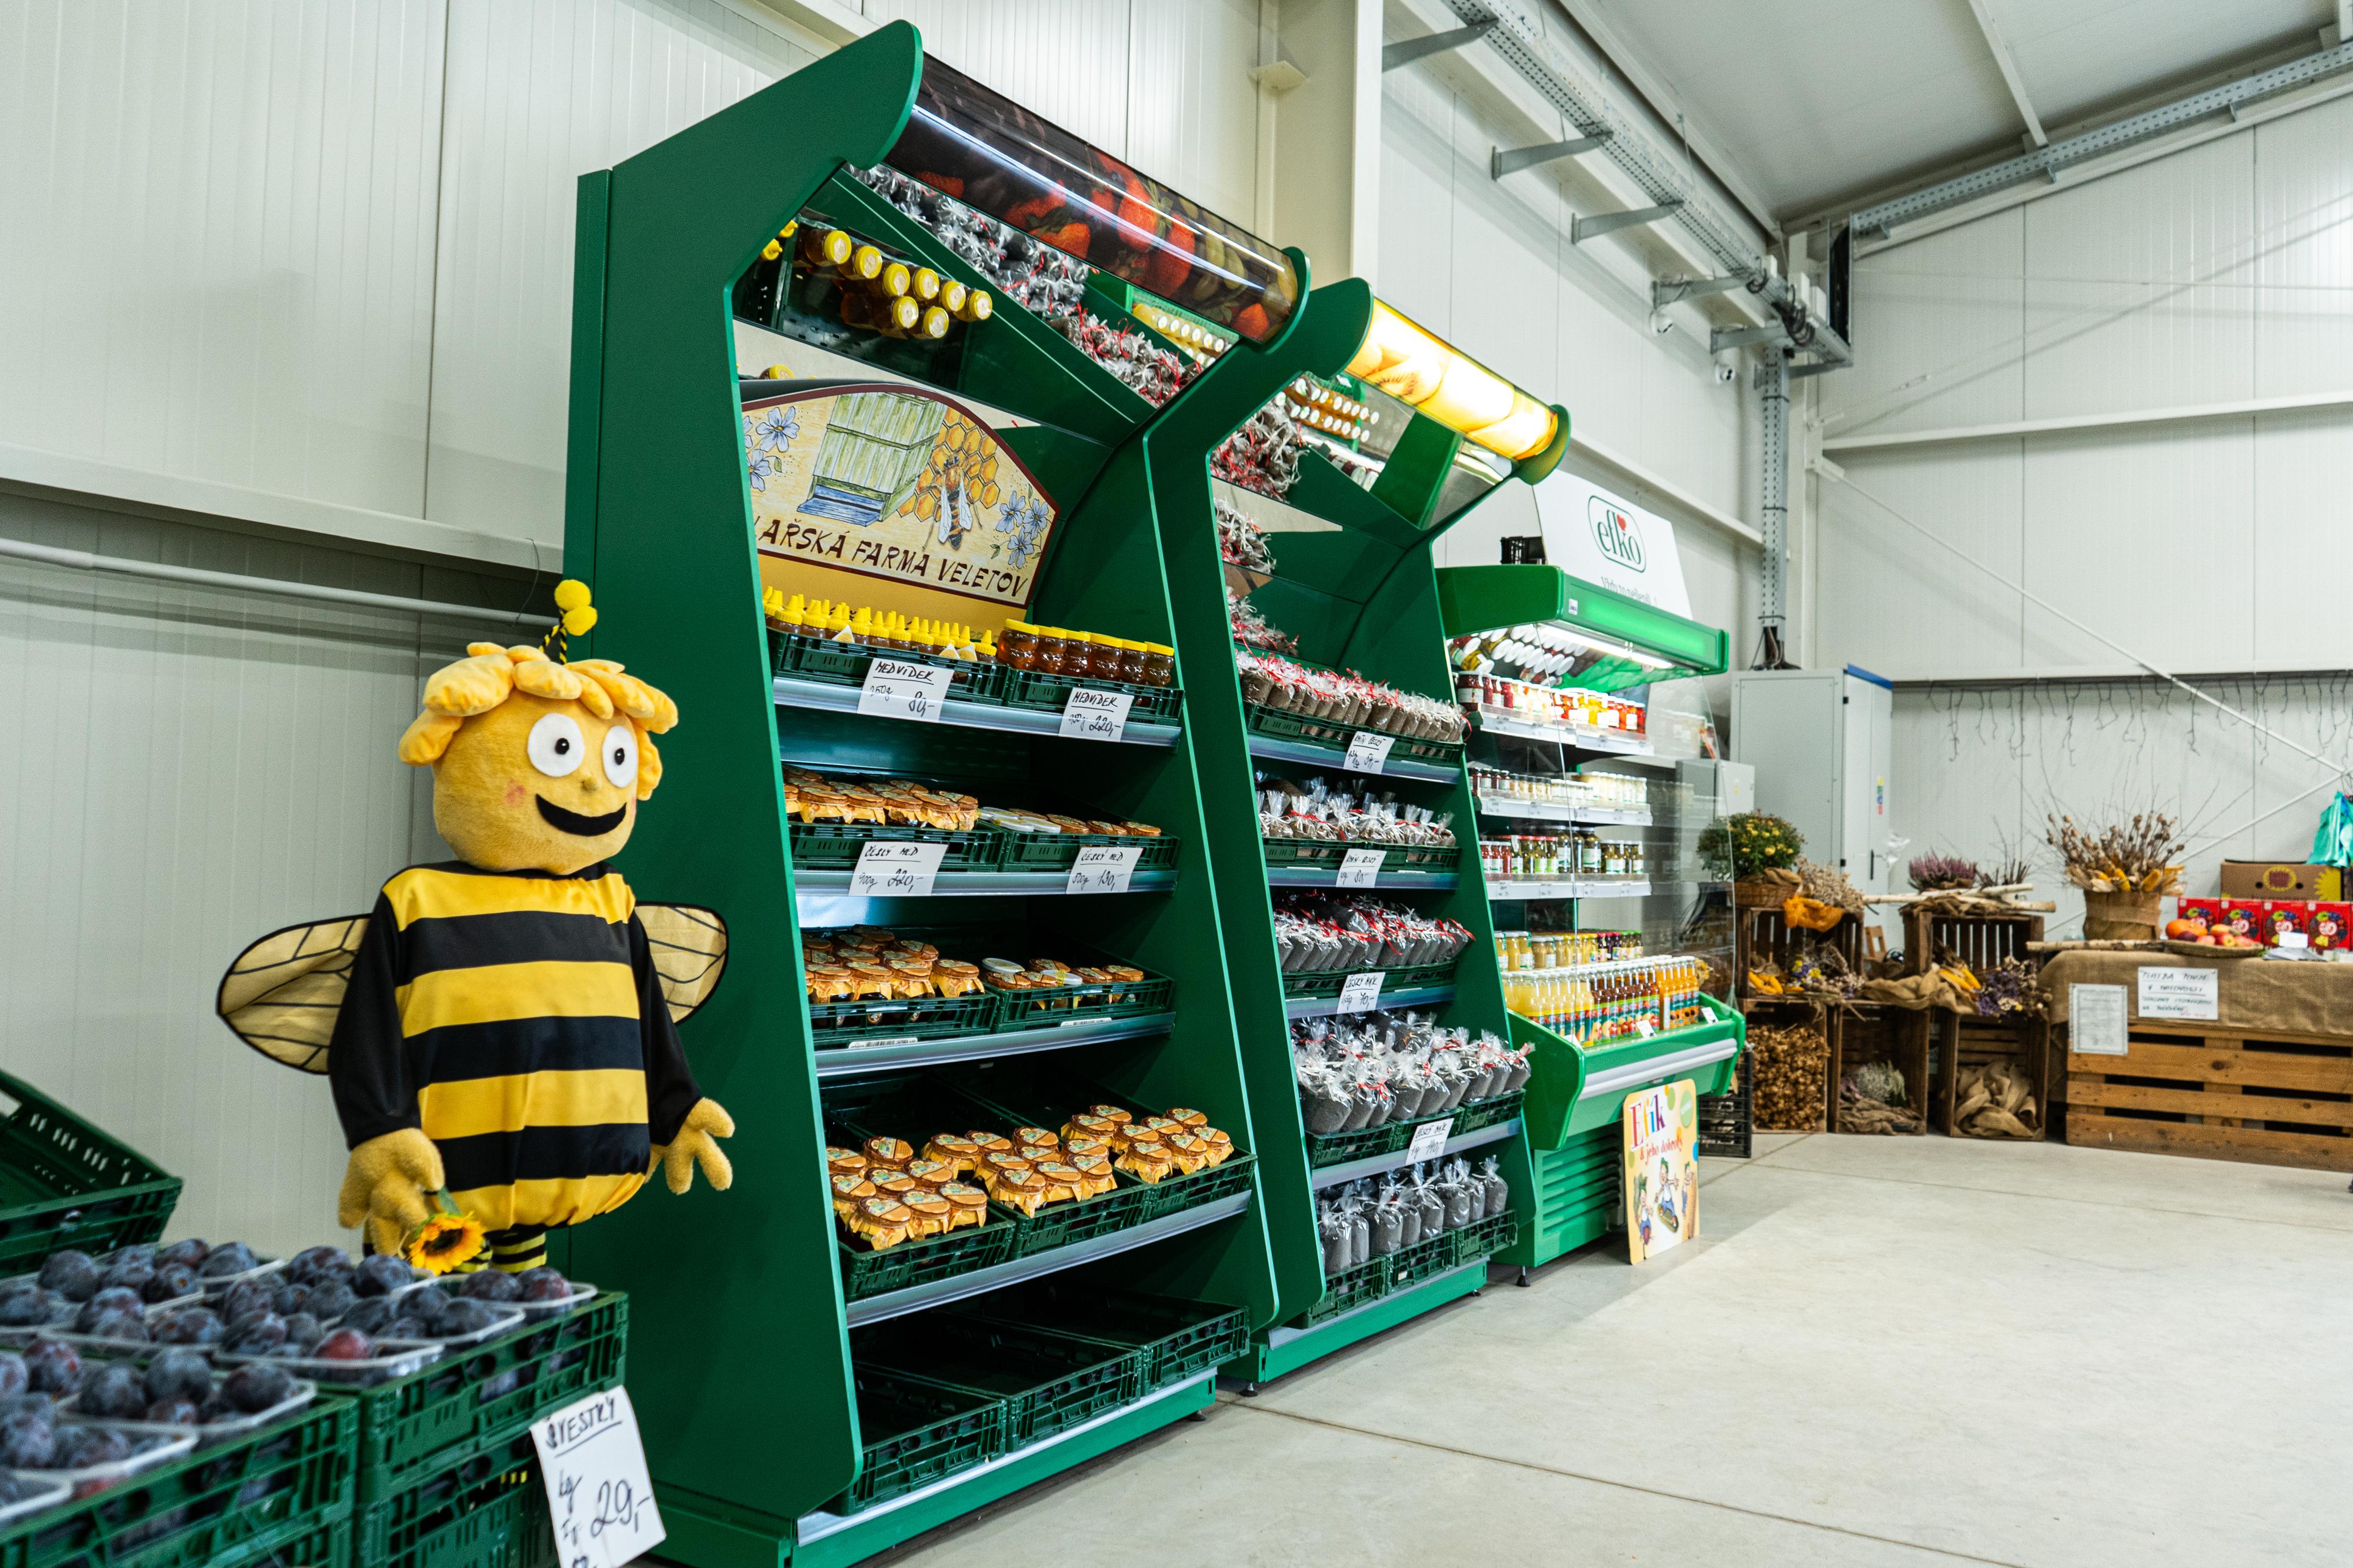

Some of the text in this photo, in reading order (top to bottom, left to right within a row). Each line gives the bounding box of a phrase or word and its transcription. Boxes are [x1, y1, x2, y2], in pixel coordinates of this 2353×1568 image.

[852, 540, 929, 577] FARMA
[938, 559, 1028, 597] VELETOV
[1089, 715, 1121, 736] 220,-
[899, 847, 919, 855] MED
[1081, 848, 1124, 862] ČESKÝ MED
[887, 868, 924, 893] 220,-
[1097, 869, 1125, 892] 130,-
[1629, 1094, 1666, 1149] Efík
[591, 1479, 651, 1537] 29,-
